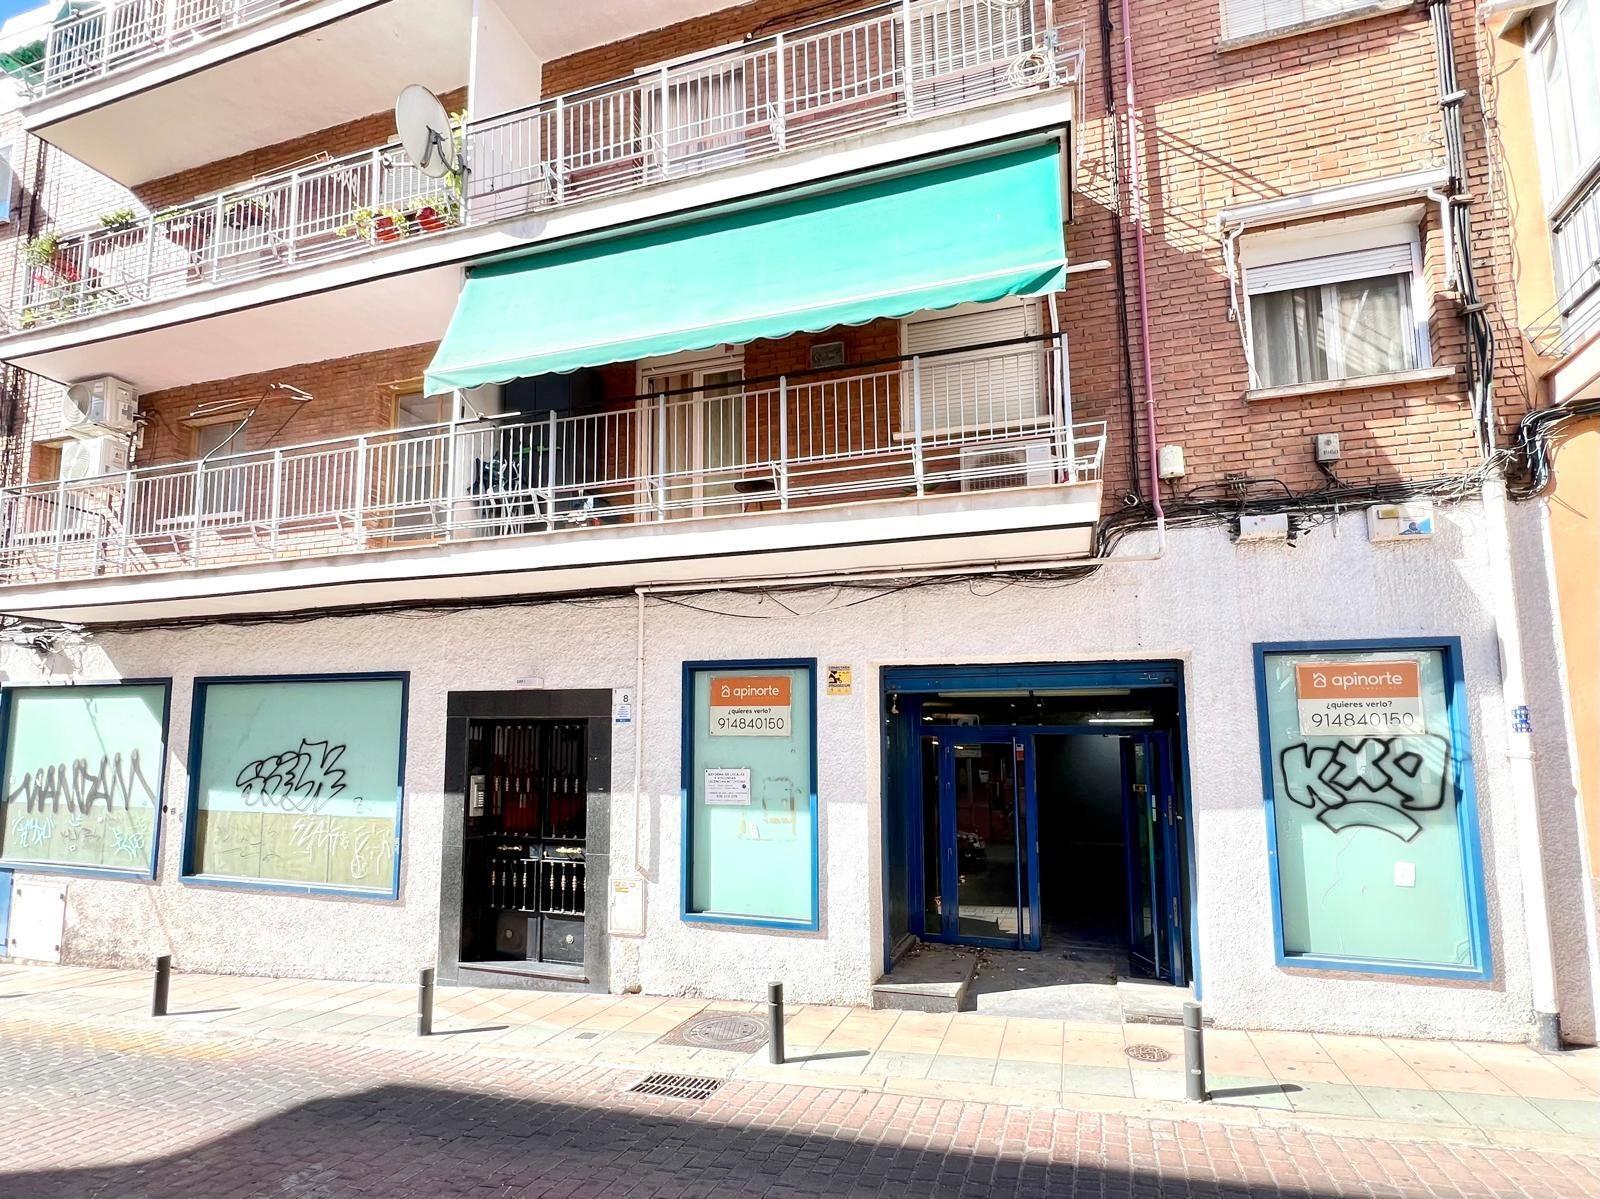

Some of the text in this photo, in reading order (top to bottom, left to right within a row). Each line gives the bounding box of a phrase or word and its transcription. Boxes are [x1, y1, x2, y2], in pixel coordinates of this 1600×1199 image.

[1331, 672, 1403, 690] apinorte
[623, 694, 629, 703] 8
[733, 685, 779, 699] apinorte
[1326, 700, 1393, 710] ¿quieres verlo?
[718, 717, 784, 730] 914840150
[1311, 712, 1414, 727] 914840150
